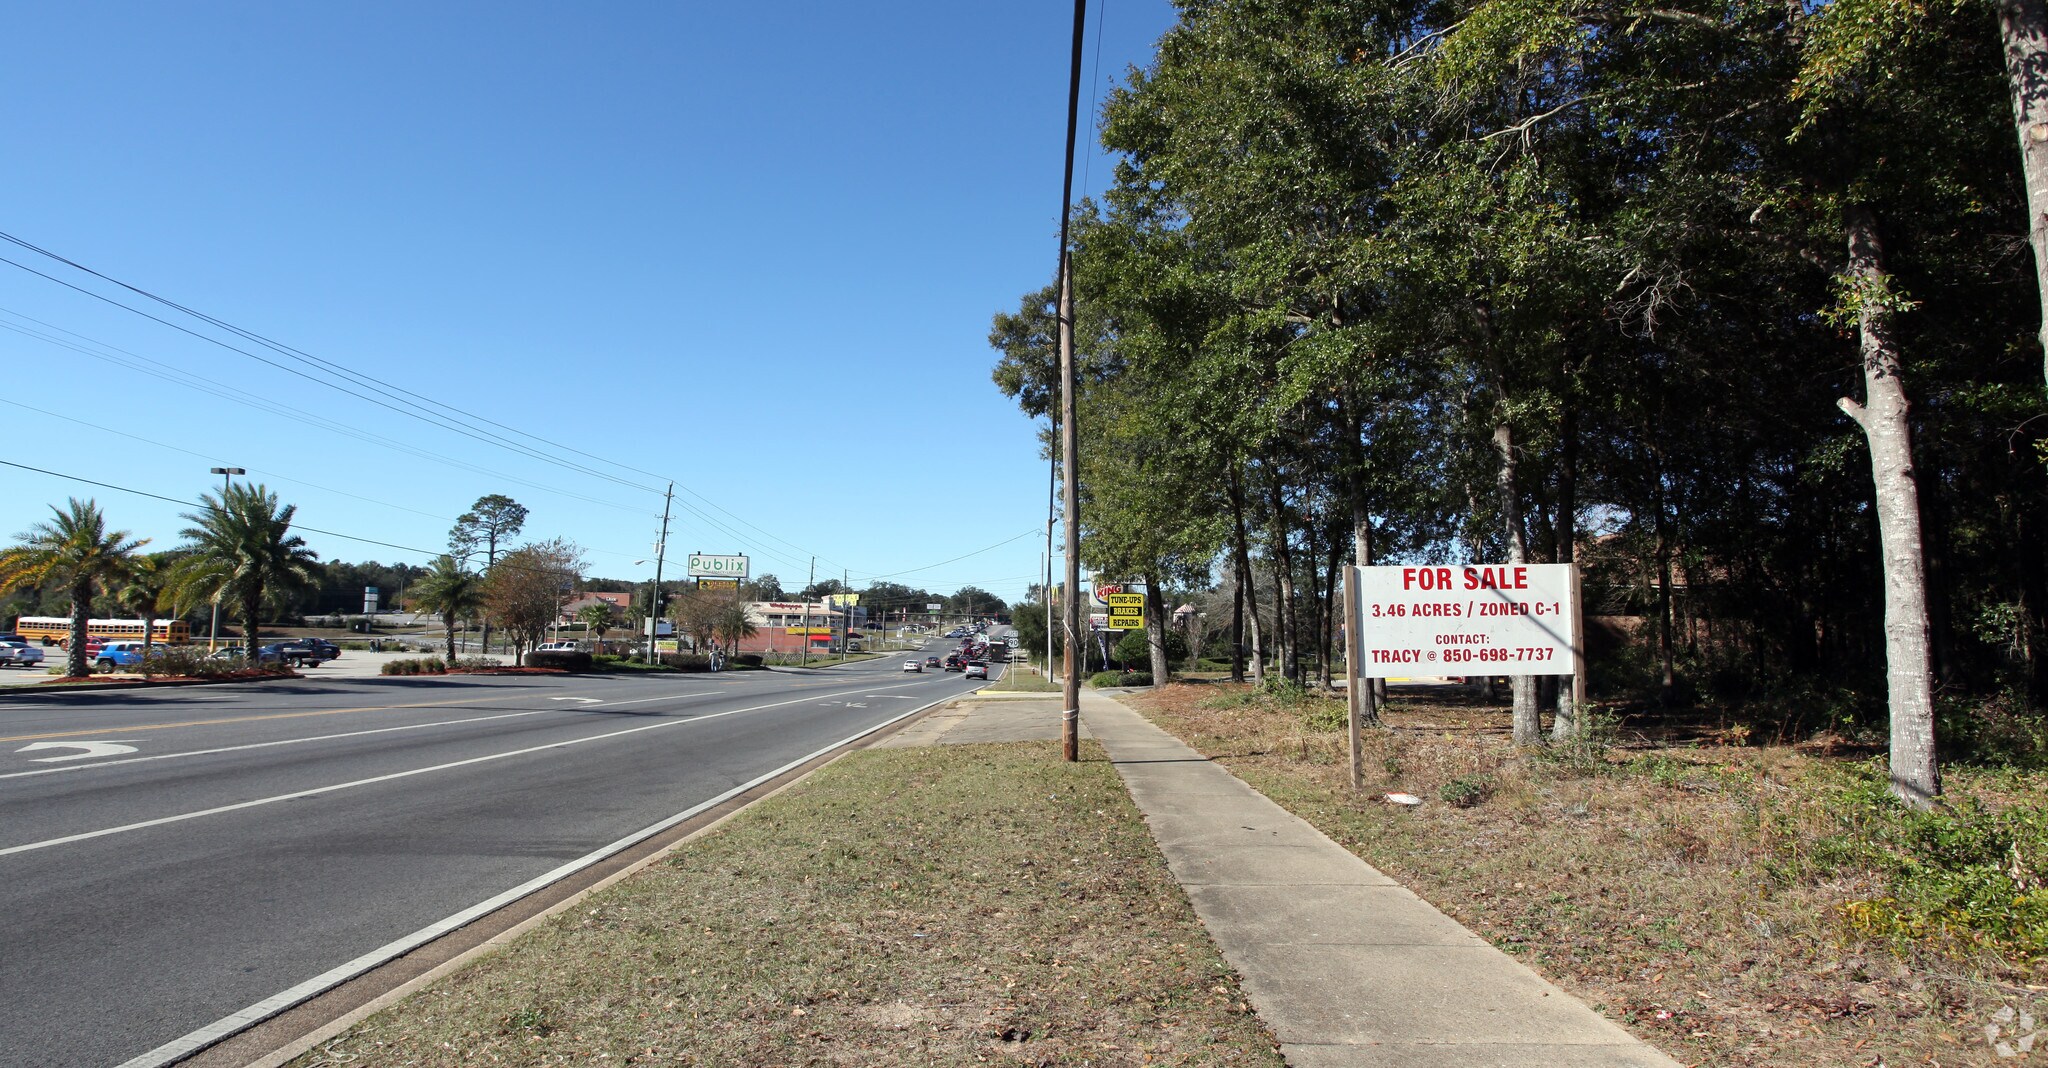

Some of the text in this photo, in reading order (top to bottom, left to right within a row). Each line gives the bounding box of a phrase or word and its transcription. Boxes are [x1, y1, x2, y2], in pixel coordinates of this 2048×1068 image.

[691, 557, 743, 571] Publix
[1403, 567, 1528, 591] FOR SALE
[1111, 596, 1142, 604] TUNE-UPS
[1113, 607, 1139, 615] BRAKES
[1372, 601, 1560, 618] 3.46 ACRES / ZONED C-1
[1436, 634, 1490, 644] CONTACT:
[1371, 648, 1554, 663] TRACY @ 850-698-7737
